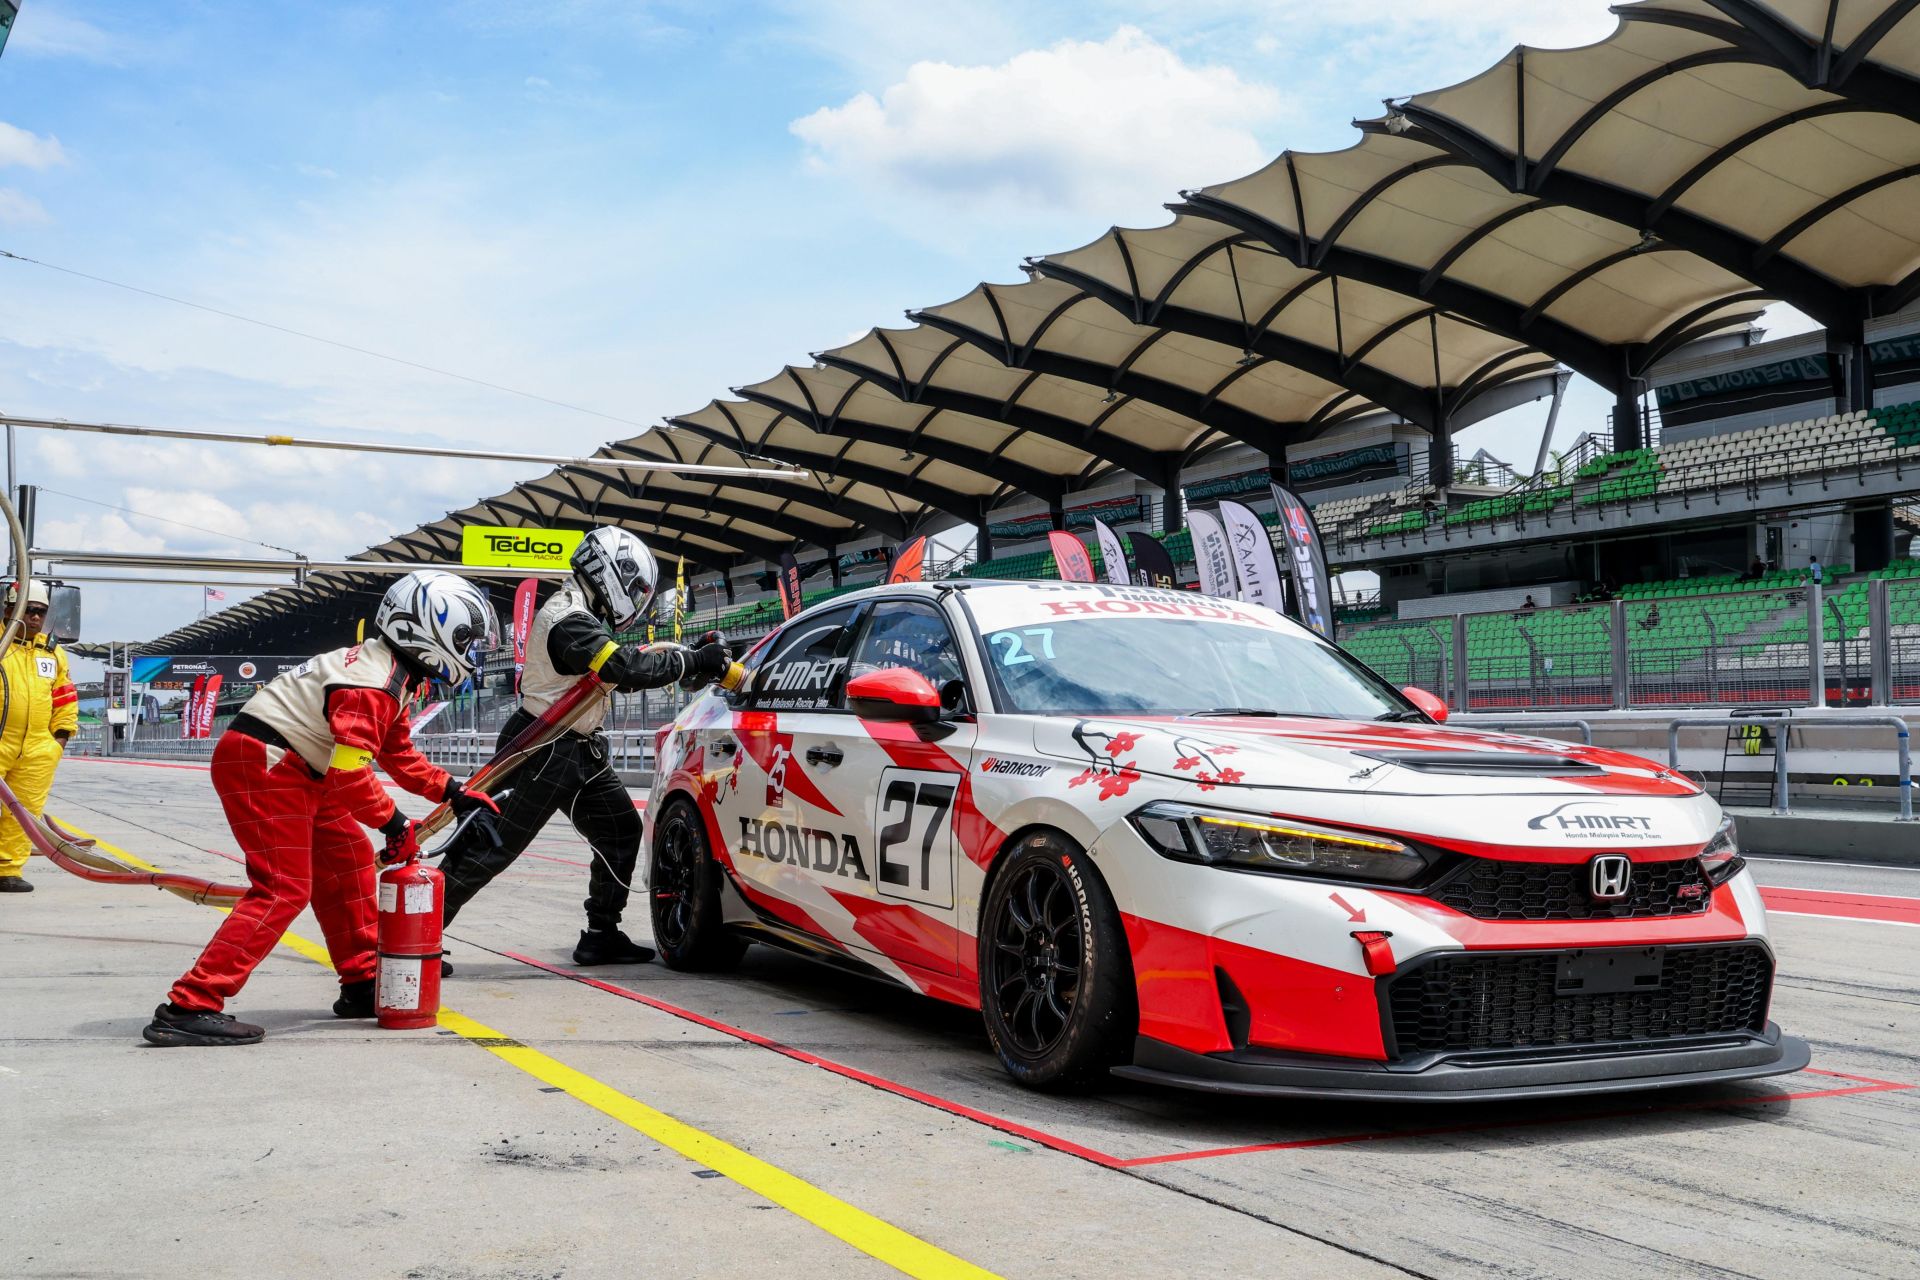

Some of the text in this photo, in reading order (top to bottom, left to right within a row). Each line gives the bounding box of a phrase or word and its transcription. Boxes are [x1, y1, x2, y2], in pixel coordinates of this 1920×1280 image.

[484, 535, 563, 554] Tedco
[1040, 600, 1274, 627] HONDA
[991, 628, 1057, 666] 27
[41, 662, 53, 673] 97
[762, 657, 849, 691] HMRT
[201, 690, 217, 727] MOTUL
[1744, 738, 1761, 755] IN
[767, 744, 791, 794] 25
[879, 780, 956, 891] 27
[1556, 815, 1652, 829] HMRT
[739, 816, 870, 882] HONDA
[1589, 832, 1619, 840] Malaysia
[1620, 832, 1643, 840] Racing
[1677, 884, 1703, 898] RS
